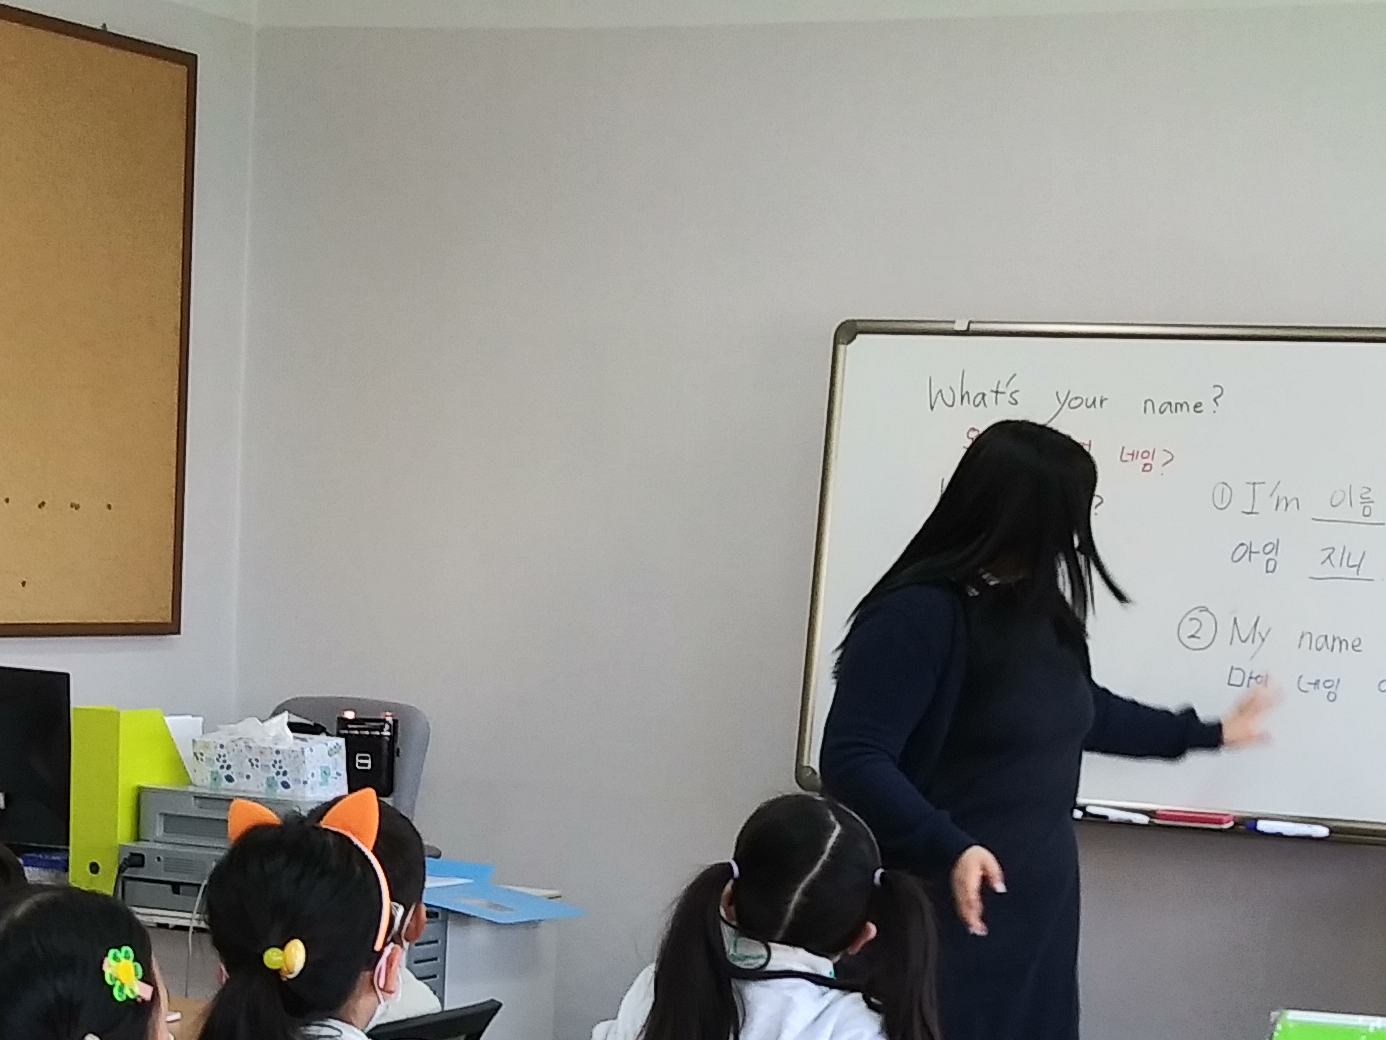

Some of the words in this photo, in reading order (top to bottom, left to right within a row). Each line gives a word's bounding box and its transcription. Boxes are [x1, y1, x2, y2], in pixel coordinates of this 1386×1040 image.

[927, 368, 1021, 412] What's
[1044, 388, 1109, 426] your
[1142, 384, 1225, 415] name?
[1119, 446, 1175, 476] 네임?
[1240, 480, 1301, 515] I'm
[1329, 484, 1375, 518] 이름
[1230, 537, 1280, 574] 아임
[1319, 545, 1366, 576] 지니
[1229, 614, 1272, 661] My
[1297, 630, 1363, 653] name
